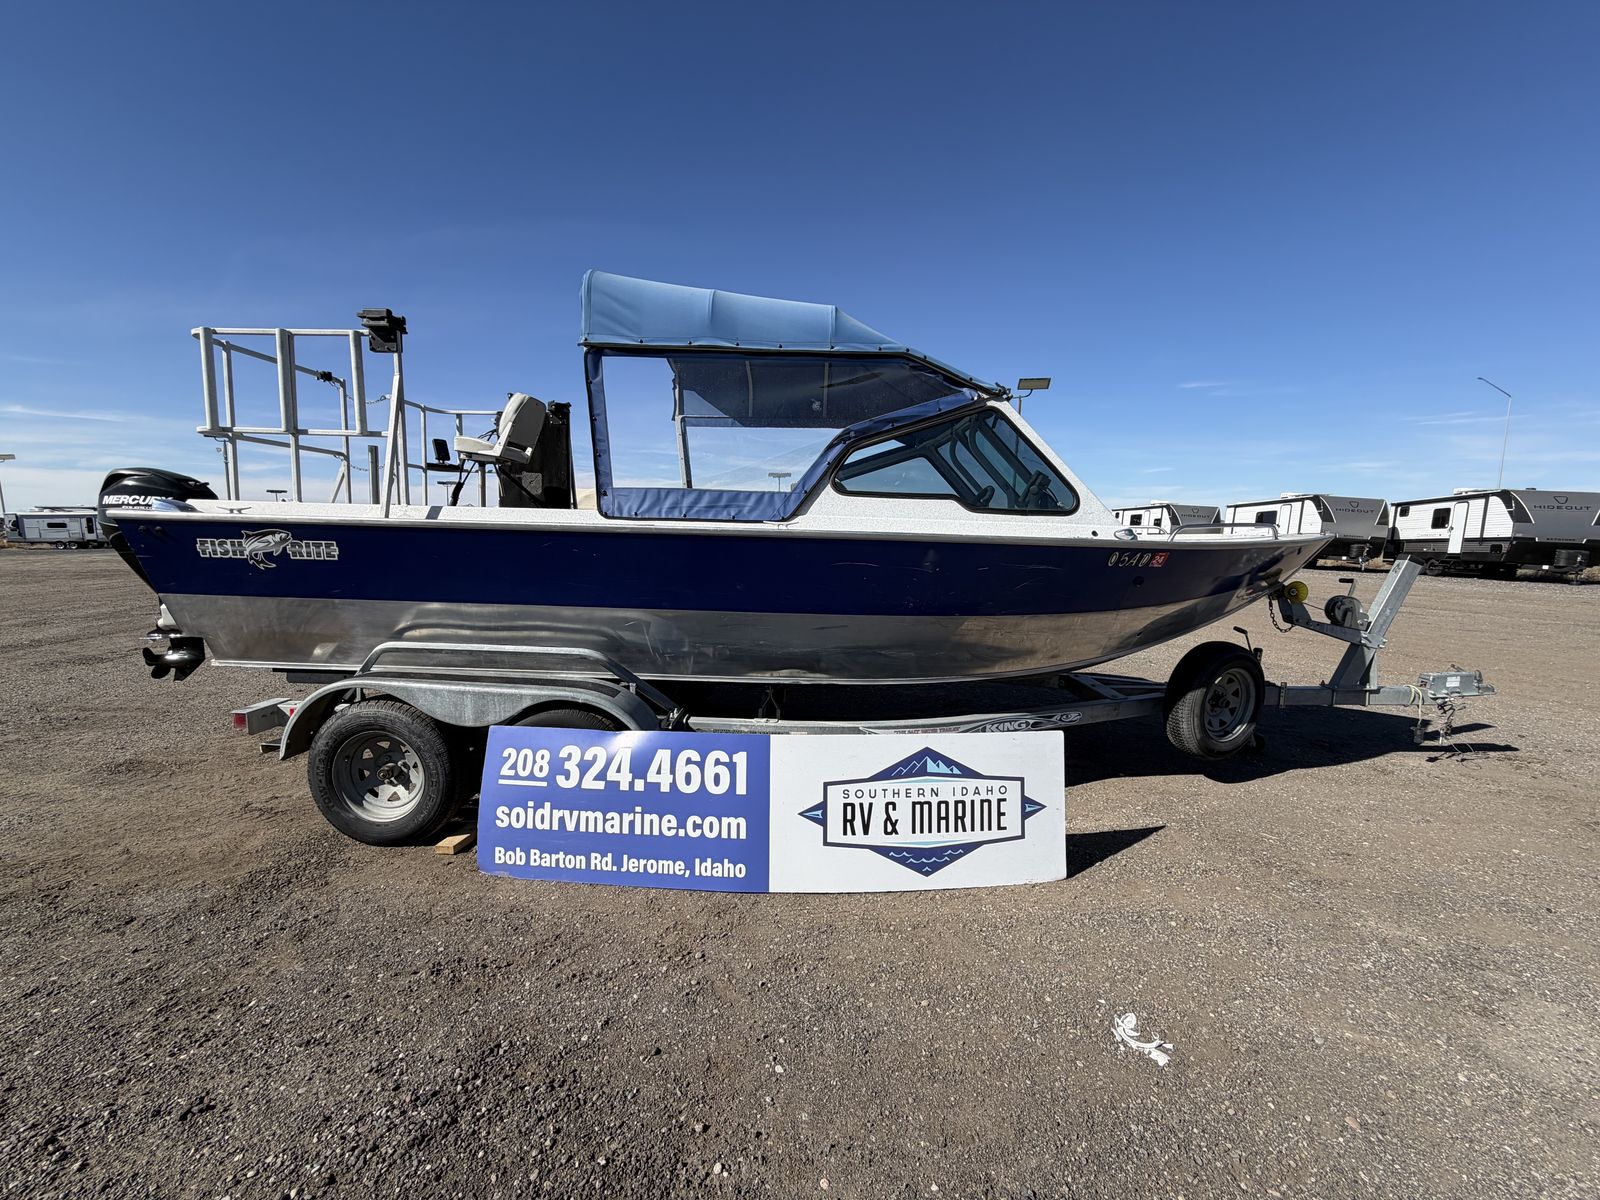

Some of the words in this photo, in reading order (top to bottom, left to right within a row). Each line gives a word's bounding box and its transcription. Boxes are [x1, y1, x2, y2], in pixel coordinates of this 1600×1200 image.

[197, 538, 247, 559] FISH
[287, 540, 339, 561] RITE
[500, 747, 550, 778] 208
[555, 745, 747, 795] 324.4661
[842, 786, 940, 799] SOUTHERN
[952, 785, 1008, 797] IDAHO
[495, 801, 747, 839] soidrvmarine.com
[842, 801, 873, 836] RV
[883, 801, 899, 836] &
[911, 798, 1008, 834] MARINE
[494, 847, 526, 864] Bob
[530, 849, 586, 870] Barton
[590, 852, 617, 872] Rd.
[620, 854, 690, 878] Jerome,
[695, 858, 746, 878] Idaho
